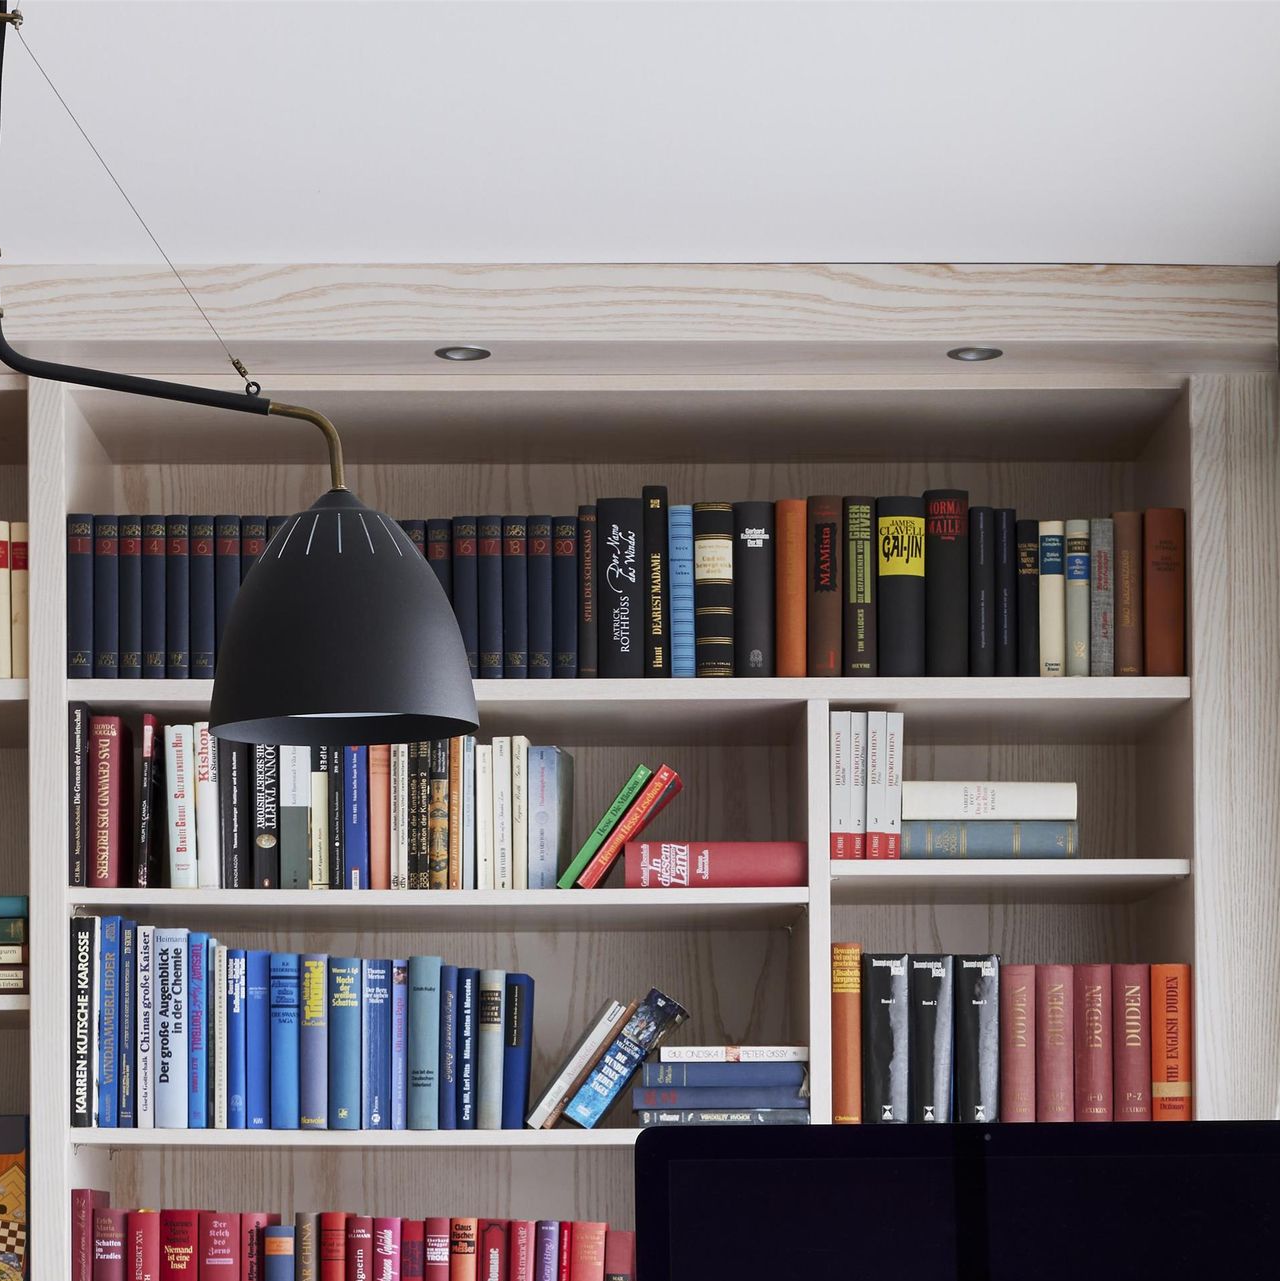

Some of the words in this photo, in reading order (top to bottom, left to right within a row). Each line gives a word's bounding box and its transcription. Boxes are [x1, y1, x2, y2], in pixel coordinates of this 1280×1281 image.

[606, 524, 620, 554] Name
[849, 506, 860, 538] GREEN
[860, 505, 871, 539] RIVER
[879, 526, 924, 536] CLAVELL
[619, 531, 635, 564] Windes
[820, 527, 830, 585] MAMista
[883, 535, 922, 563] GAI-JIN
[651, 553, 661, 593] MADAME
[620, 596, 629, 652] ROTHFUSS
[652, 595, 662, 634] DEAREST
[653, 647, 662, 667] Hunt
[98, 739, 110, 759] DAS
[198, 728, 209, 782] Kishon
[98, 762, 110, 806] GEWAND
[257, 759, 265, 790] SECRET
[97, 809, 109, 828] DES
[257, 793, 265, 829] HISTORY
[265, 787, 276, 828] TARTT
[96, 830, 109, 878] ERLÖSERS
[140, 932, 149, 972] Kaiser
[156, 935, 188, 943] Heimann
[78, 931, 89, 988] KAROSSE
[172, 948, 182, 995] Chemie
[140, 975, 151, 1008] große
[159, 948, 171, 1017] Augenblick
[1166, 977, 1178, 1013] DUDEN
[77, 995, 88, 1054] KUTSCHE
[103, 952, 115, 1084] WINDJAMMERLIEDER
[172, 999, 182, 1019] der
[172, 1021, 182, 1033] in
[1126, 985, 1141, 1047] DUDEN
[140, 1011, 150, 1052] Chinas
[159, 1022, 171, 1058] große
[1166, 1018, 1178, 1059] ENGLISH
[76, 1060, 87, 1113] KARREN
[159, 1060, 169, 1083] Der
[164, 1245, 193, 1255] Niemand
[302, 1223, 311, 1264] CHINA
[453, 1231, 474, 1239] Fischer
[171, 1261, 187, 1270] Insel
